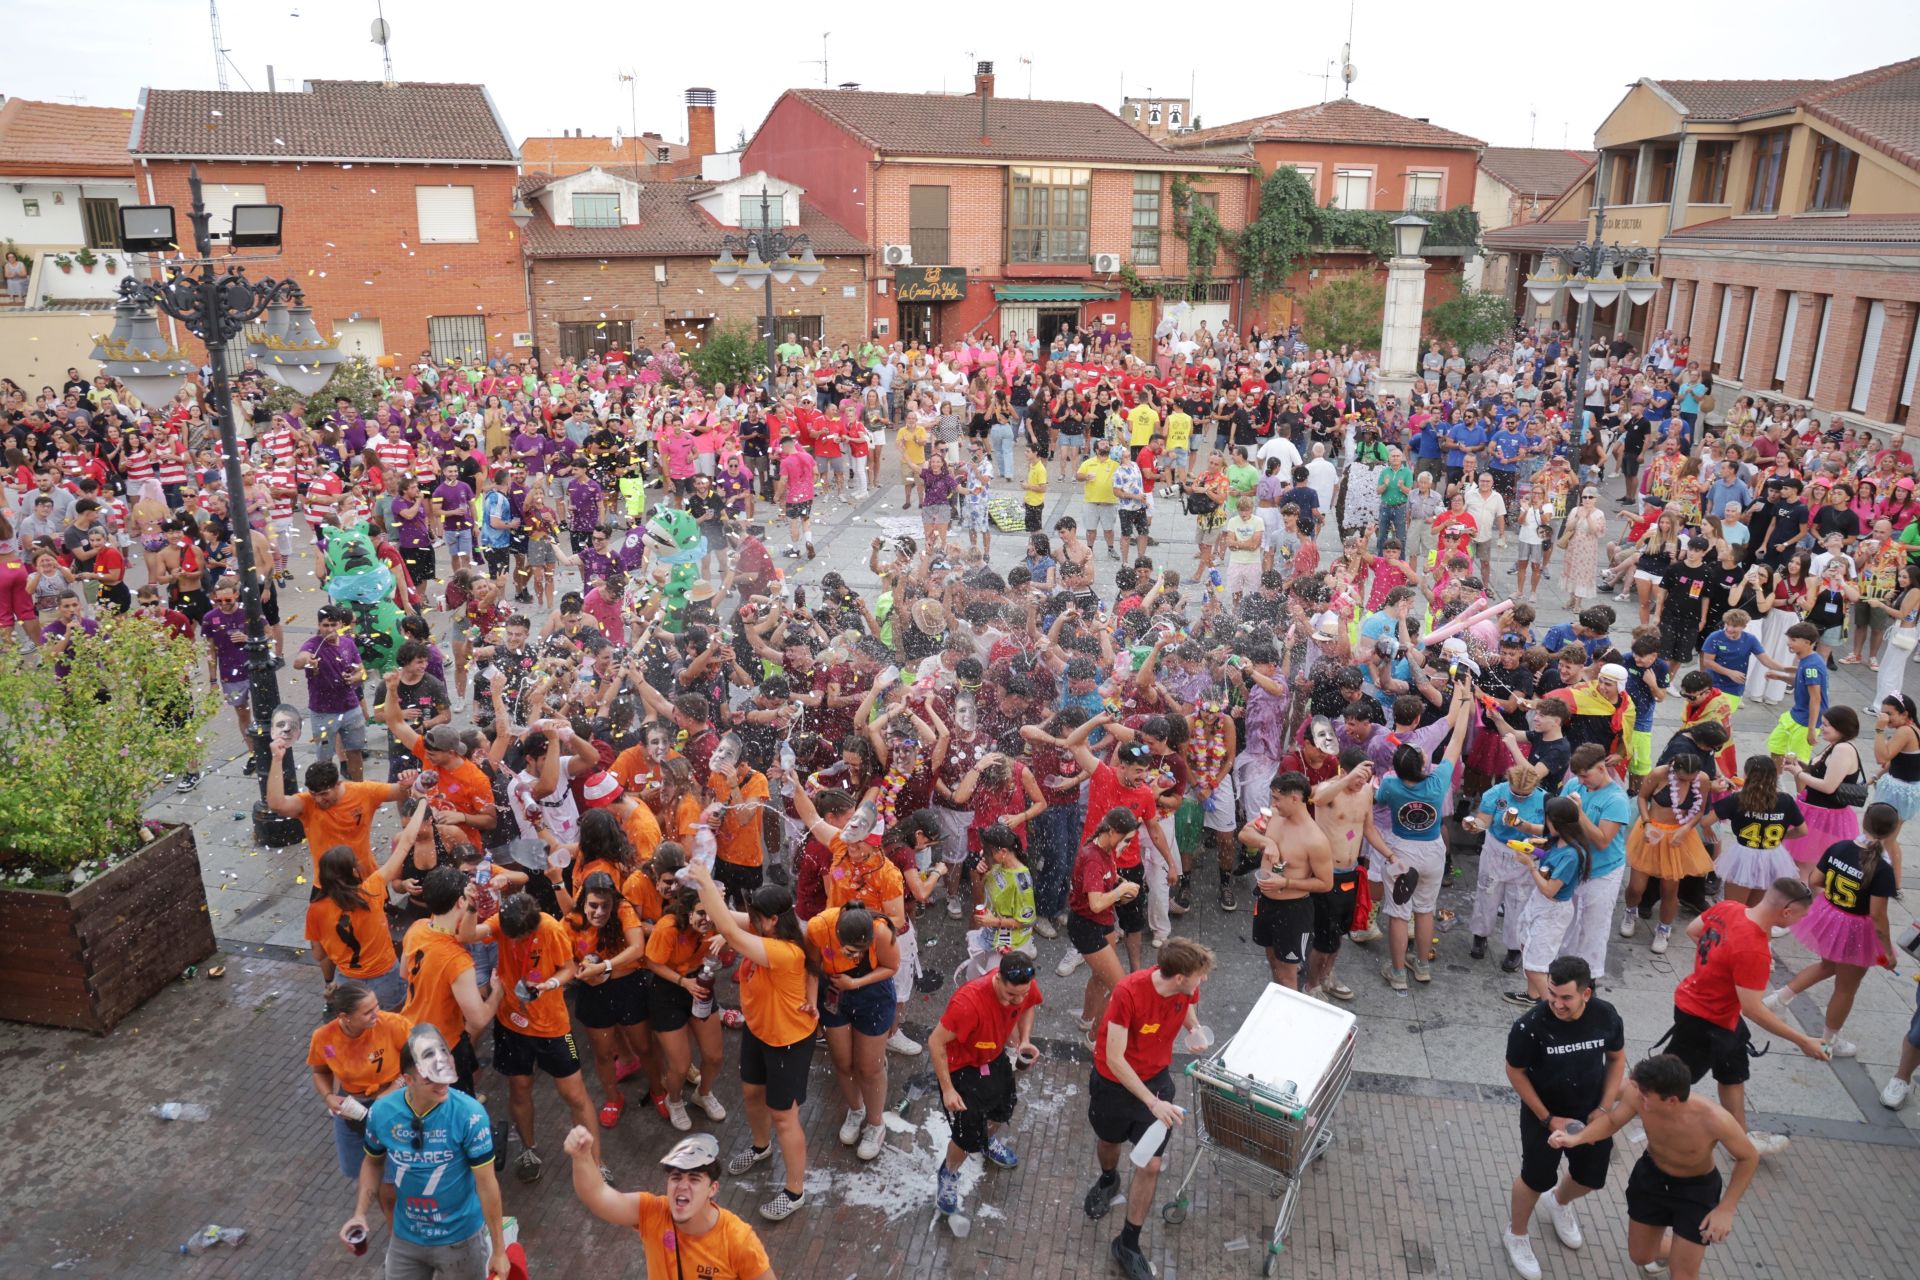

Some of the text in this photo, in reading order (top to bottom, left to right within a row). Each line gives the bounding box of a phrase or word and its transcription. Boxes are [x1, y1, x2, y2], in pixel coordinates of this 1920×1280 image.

[898, 283, 908, 300] La
[928, 283, 941, 299] De
[1805, 667, 1818, 679] 90
[1752, 811, 1769, 820] PALO
[1739, 822, 1785, 849] 48
[1827, 855, 1864, 880] A PALO SEKO
[1825, 868, 1861, 908] 15
[1546, 1038, 1605, 1055] DIECISIETE
[371, 1056, 384, 1073] 7
[697, 1264, 720, 1276] DBP
